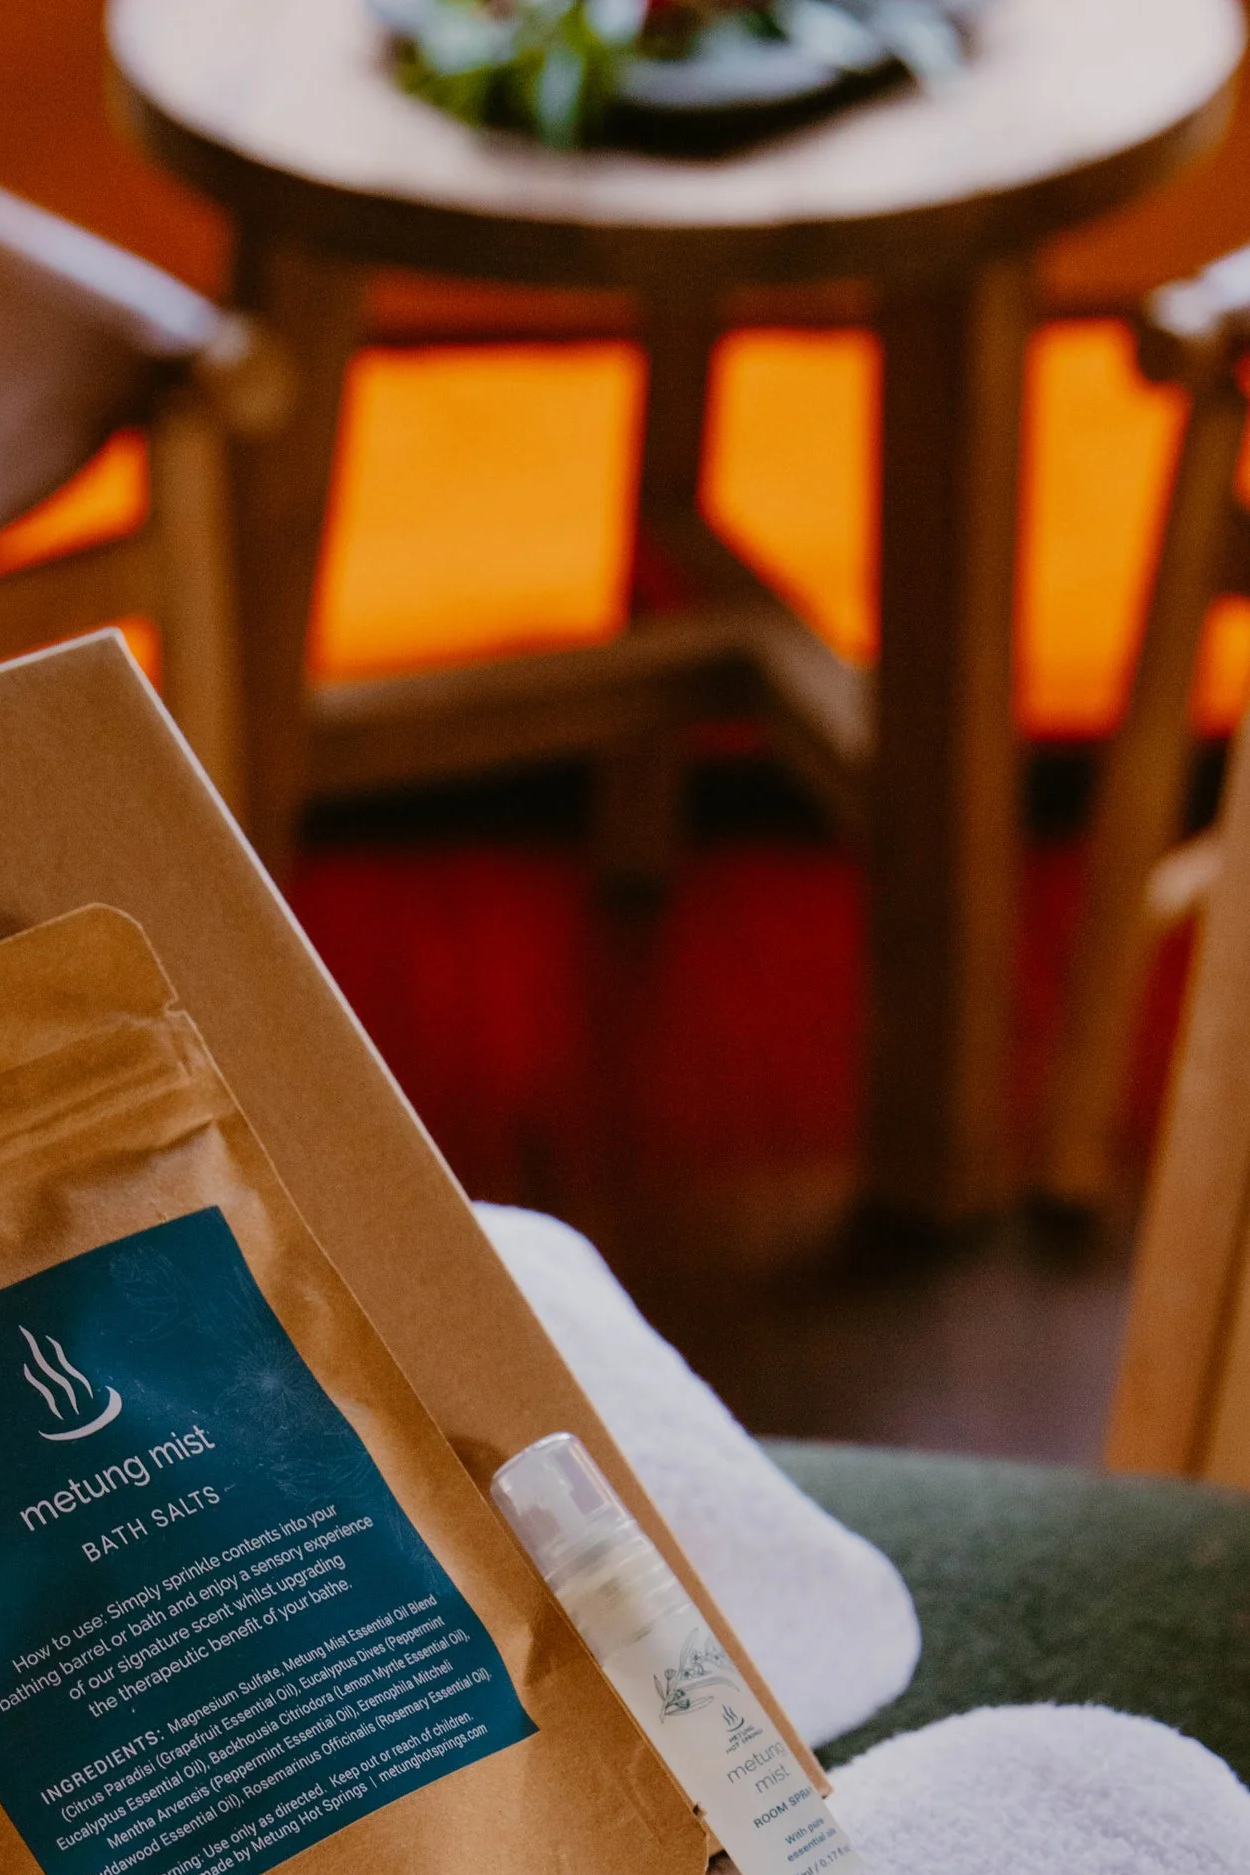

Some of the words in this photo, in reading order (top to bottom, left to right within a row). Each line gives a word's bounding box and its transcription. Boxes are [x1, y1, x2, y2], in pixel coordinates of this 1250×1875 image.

[19, 1455, 151, 1532] metung
[148, 1424, 215, 1469] mist
[81, 1518, 148, 1563] BATH
[151, 1486, 220, 1528] SALTS
[12, 1644, 51, 1674] How
[51, 1635, 71, 1650] to
[72, 1613, 107, 1639] use:
[106, 1584, 161, 1619] Simply
[162, 1556, 221, 1591] sprinkle
[221, 1529, 282, 1562] contents
[278, 1518, 308, 1536] into
[306, 1504, 337, 1529] your
[58, 1638, 112, 1675] barrel
[110, 1630, 128, 1647] or
[127, 1610, 167, 1637] bath
[167, 1591, 199, 1617] and
[199, 1574, 239, 1600] enjoy
[238, 1570, 251, 1582] a
[250, 1545, 304, 1576] sensory
[303, 1516, 374, 1553] experience
[69, 1679, 86, 1700] of
[88, 1666, 115, 1689] our
[117, 1627, 190, 1673] signature
[191, 1603, 234, 1633] scent
[232, 1582, 278, 1611] whilst
[275, 1554, 346, 1592] upgrading
[88, 1696, 118, 1718] the
[117, 1646, 209, 1701] therapeutic
[207, 1617, 263, 1652] benefit
[262, 1607, 278, 1625] of
[277, 1596, 309, 1622] your
[307, 1579, 353, 1604] bathe.
[40, 1729, 165, 1805] INGREDIENTS:
[166, 1690, 239, 1734] Magnesium
[238, 1668, 285, 1695] Sulfate,
[281, 1646, 327, 1672] Metung
[323, 1634, 350, 1652] Mist
[347, 1612, 395, 1642] Essential
[393, 1605, 410, 1621] Oil
[407, 1593, 438, 1615] Blend
[56, 1806, 127, 1851] Eucalyptus
[125, 1770, 184, 1812] Essential
[183, 1758, 211, 1779] Oil),
[208, 1721, 280, 1765] Backhousia
[278, 1692, 335, 1725] Citriodora
[333, 1674, 374, 1700] (Lemon
[371, 1658, 406, 1680] Myrtle
[403, 1636, 450, 1665] Essential
[448, 1628, 471, 1645] Oil),
[61, 1792, 105, 1823] (Citrus
[103, 1759, 156, 1797] Paradisi
[155, 1724, 223, 1770] (Grapefruit
[221, 1692, 277, 1731] Essential
[276, 1682, 302, 1701] Oil),
[298, 1656, 358, 1689] Eucalyptus
[355, 1643, 386, 1663] Dives
[384, 1615, 446, 1652] (Peppermint
[106, 1817, 156, 1849] Mentha
[210, 1742, 285, 1793] (Peppermint
[282, 1713, 337, 1750] Essential
[335, 1704, 360, 1722] Oil),
[356, 1679, 415, 1712] Eremophila
[159, 1805, 218, 1846] Essential
[217, 1793, 245, 1813] Oil),
[242, 1750, 322, 1799] Rosemarinus
[321, 1722, 377, 1755] Officinalis
[375, 1697, 430, 1731] (Rosemary
[427, 1674, 473, 1704] Essential
[727, 1741, 786, 1784] metung
[202, 1839, 230, 1858] Use
[230, 1822, 257, 1843] only
[258, 1813, 275, 1828] as
[328, 1766, 360, 1788] Keep
[360, 1755, 380, 1772] out
[379, 1749, 391, 1762] or
[391, 1734, 422, 1756] reach
[420, 1727, 433, 1742] of
[232, 1847, 251, 1863] by
[250, 1820, 301, 1852] Metung
[298, 1805, 324, 1826] Hot
[322, 1783, 368, 1812] Springs
[378, 1724, 488, 1783] metunghotsprings.com
[753, 1802, 788, 1829] ROOM
[788, 1787, 814, 1807] SPRA
[754, 1764, 790, 1793] mist
[785, 1826, 808, 1845] With
[787, 1832, 826, 1862] essential
